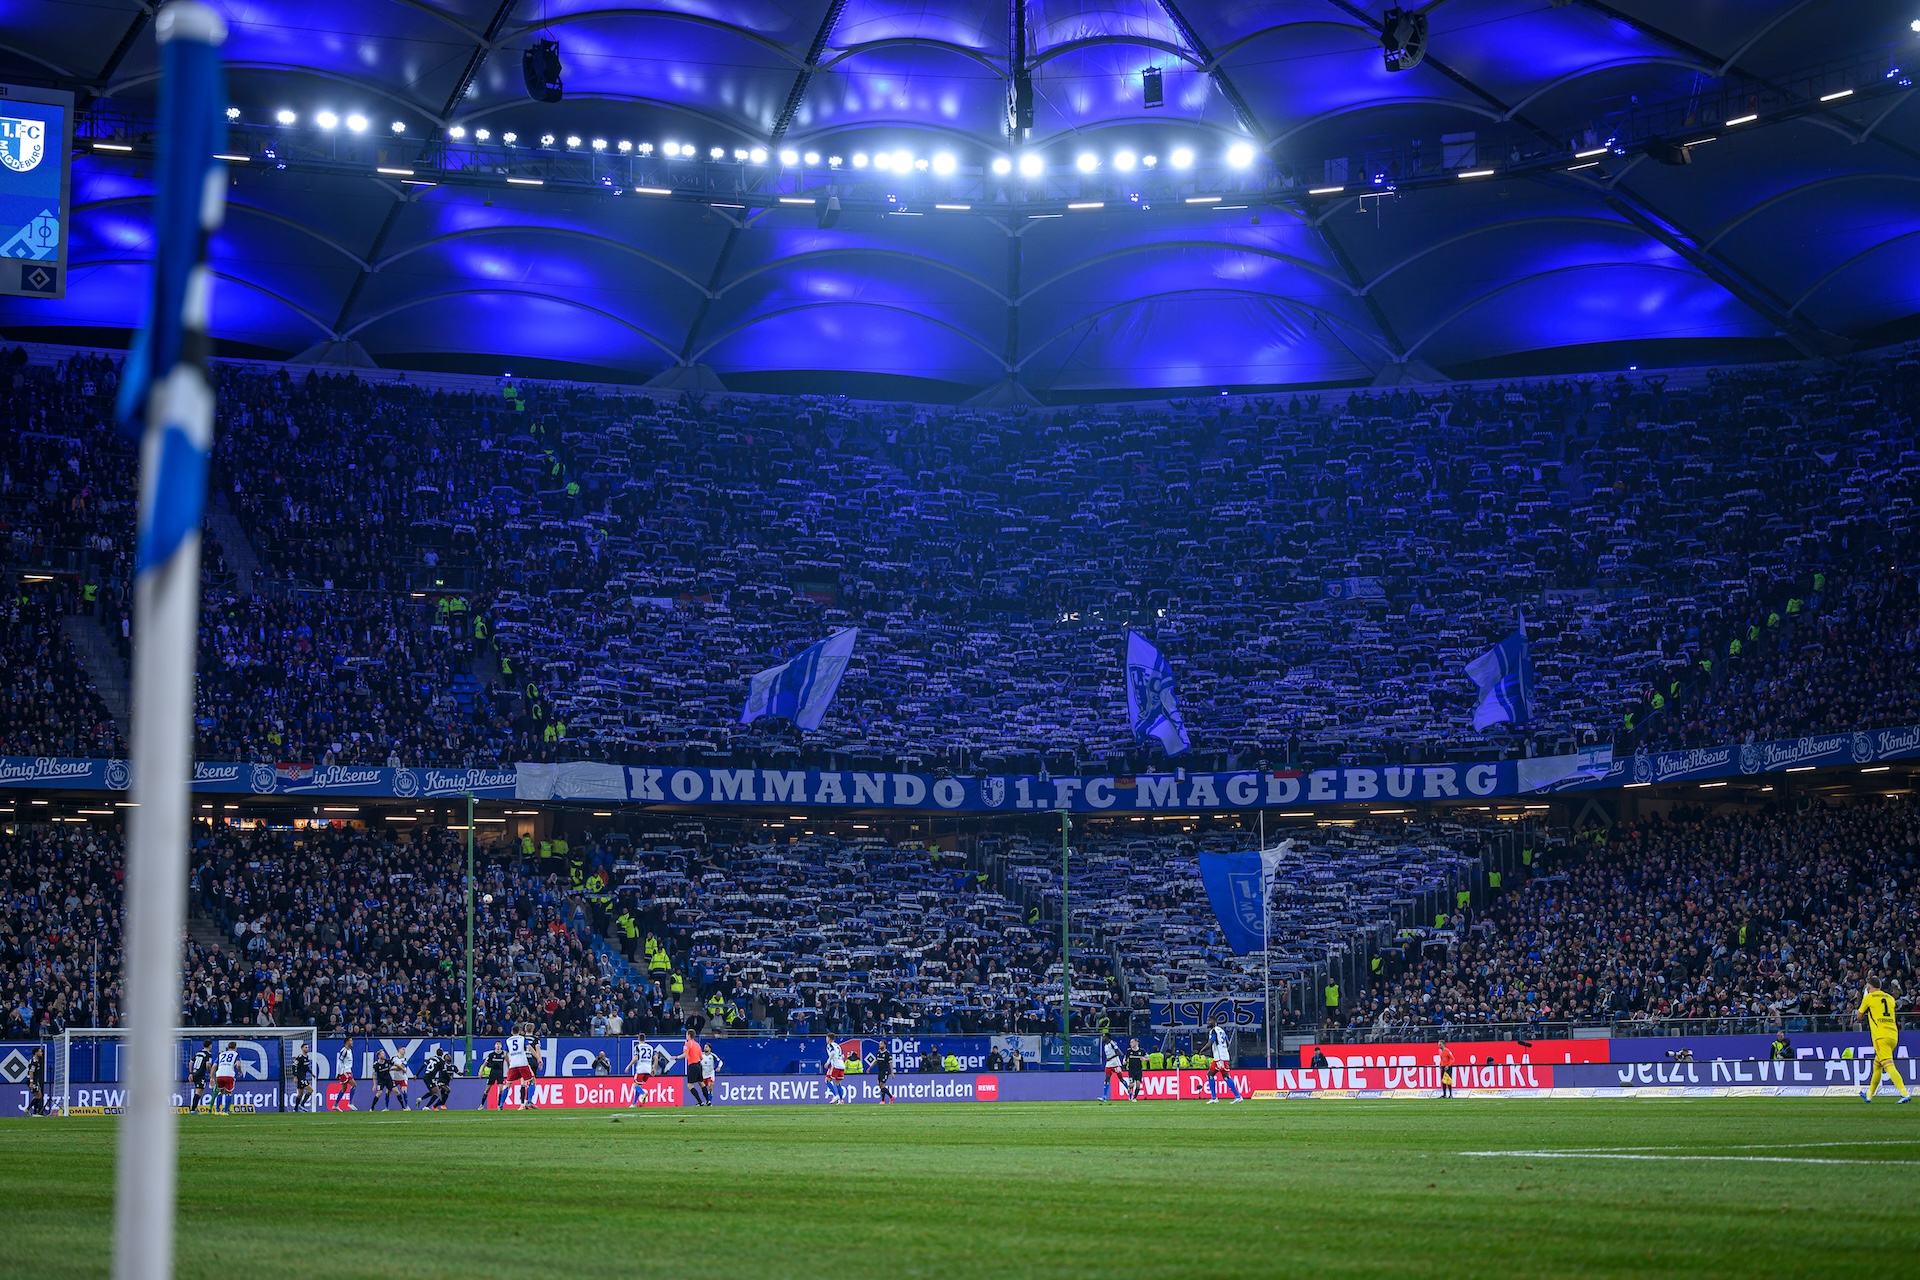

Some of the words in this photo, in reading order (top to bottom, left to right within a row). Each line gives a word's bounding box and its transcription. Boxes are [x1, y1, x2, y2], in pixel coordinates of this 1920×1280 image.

[1, 122, 40, 139] 1.FC
[1764, 747, 1803, 766] König
[1799, 737, 1842, 756] Pilsener
[1878, 734, 1914, 753] König
[1656, 758, 1692, 776] König
[1689, 748, 1730, 768] Pilsener
[423, 771, 466, 792] König
[630, 767, 965, 808] KOMMANDO
[1015, 776, 1117, 810] 1.FC
[1135, 764, 1498, 808] MAGDEBURG
[1881, 998, 1890, 1016] 1
[512, 1039, 519, 1051] 5
[641, 1047, 652, 1060] 23
[892, 1038, 921, 1054] Der
[1051, 1045, 1092, 1056] DESAU
[220, 1053, 234, 1063] 28
[575, 1083, 615, 1104] Dein
[720, 1082, 763, 1101] Jetzt
[769, 1081, 820, 1100] REWE
[978, 1084, 996, 1092] REWE
[233, 1105, 254, 1113] BET
